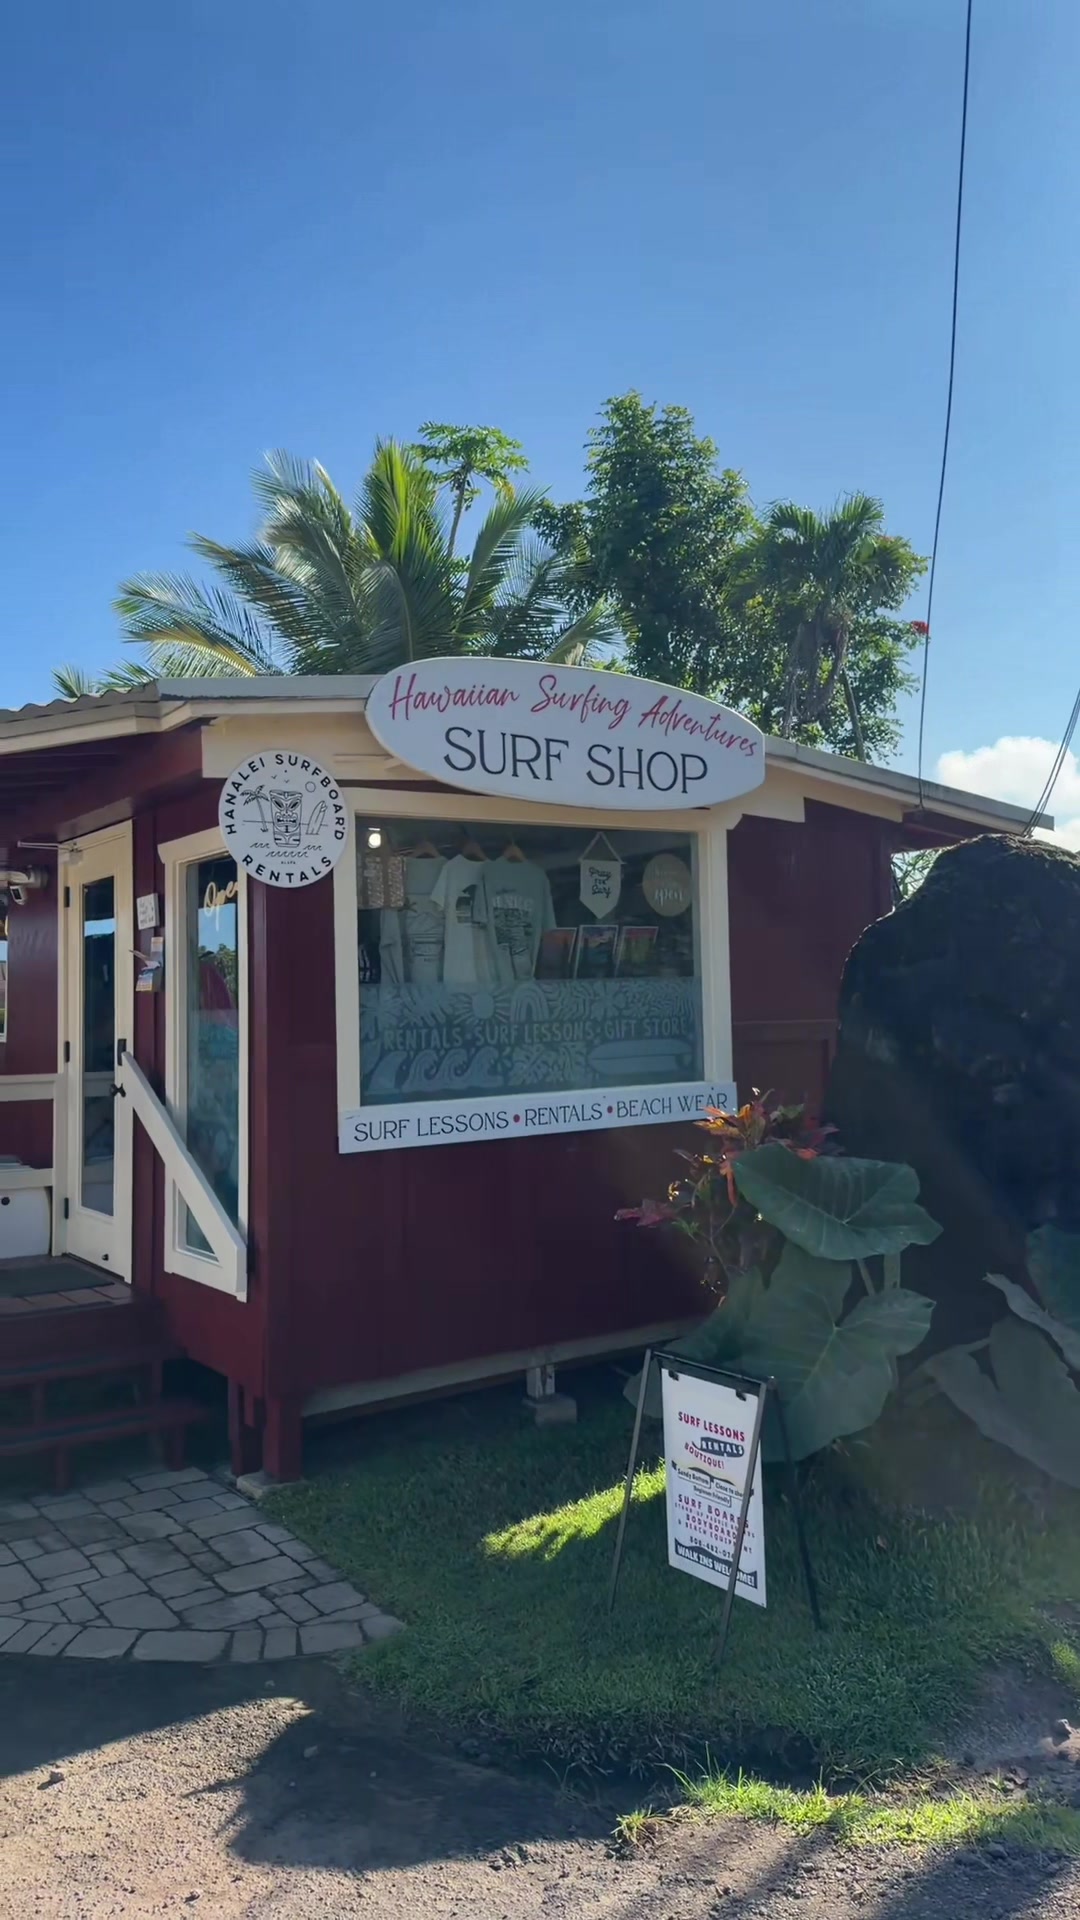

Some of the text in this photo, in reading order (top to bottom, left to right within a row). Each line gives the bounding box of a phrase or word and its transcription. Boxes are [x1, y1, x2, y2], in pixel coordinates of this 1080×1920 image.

[389, 673, 759, 757] Hawaiian Surfing Adventures
[443, 727, 708, 794] SURF SHOP
[224, 753, 345, 840] HANALEI SURFBOARD
[241, 854, 331, 883] RENTALS
[384, 1017, 688, 1050] RENTALS SURF LESSONS GIFT STORE
[354, 1093, 728, 1142] SURF LESSONS RENTALS BEACH WEAR
[678, 1411, 745, 1442] SURF LESSONS
[684, 1442, 725, 1469] BOUTIQUE!
[702, 1440, 743, 1454] RENTALS
[678, 1494, 749, 1528] SURF BOARS
[686, 1514, 737, 1540] BODYBOARD
[710, 1530, 752, 1554] EQUIPNT
[677, 1544, 699, 1559] WALK
[699, 1553, 713, 1569] INS
